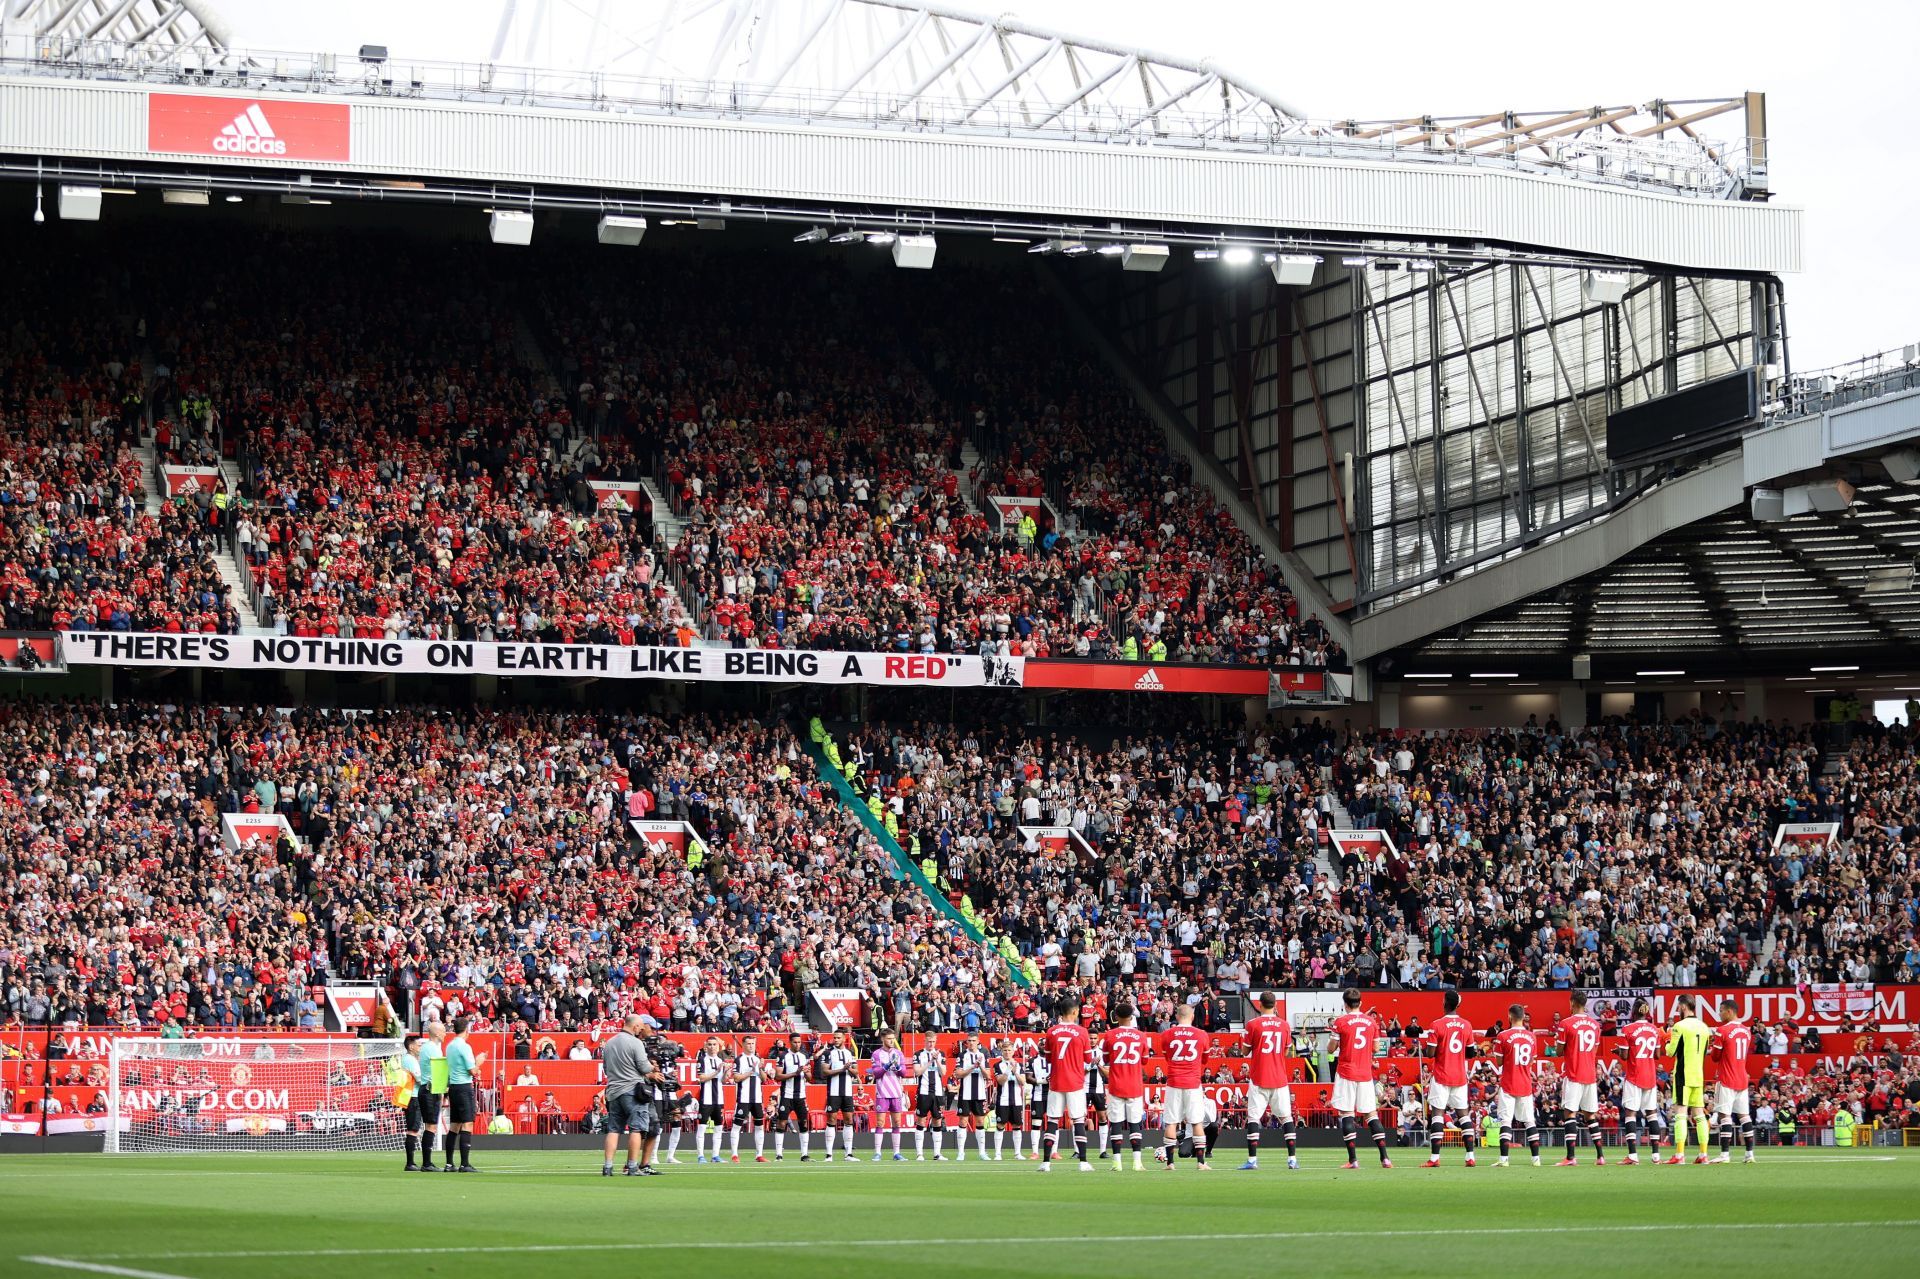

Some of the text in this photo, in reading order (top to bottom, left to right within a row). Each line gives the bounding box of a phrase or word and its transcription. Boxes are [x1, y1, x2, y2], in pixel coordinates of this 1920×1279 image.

[213, 135, 287, 155] adidas
[71, 634, 962, 680] "THERE'S NOTHING ON EARTH LIKE BEING A RED"
[1134, 681, 1164, 690] adidas
[1582, 990, 1600, 998] EAD
[1632, 988, 1650, 996] THE
[1051, 1027, 1079, 1037] RONALDO
[1115, 1031, 1140, 1041] SANCHO
[1446, 1021, 1465, 1029] POGBA
[1057, 1036, 1072, 1060] 7
[1261, 1031, 1282, 1054] 31
[1353, 1026, 1367, 1050] 5
[1449, 1031, 1463, 1054] 6
[1577, 1029, 1596, 1052] 19
[1635, 1036, 1657, 1059] 29
[1695, 1034, 1700, 1054] 1
[1736, 1037, 1747, 1060] 11
[1112, 1041, 1141, 1065] 25
[1169, 1039, 1198, 1062] 23
[1513, 1043, 1532, 1066] 18
